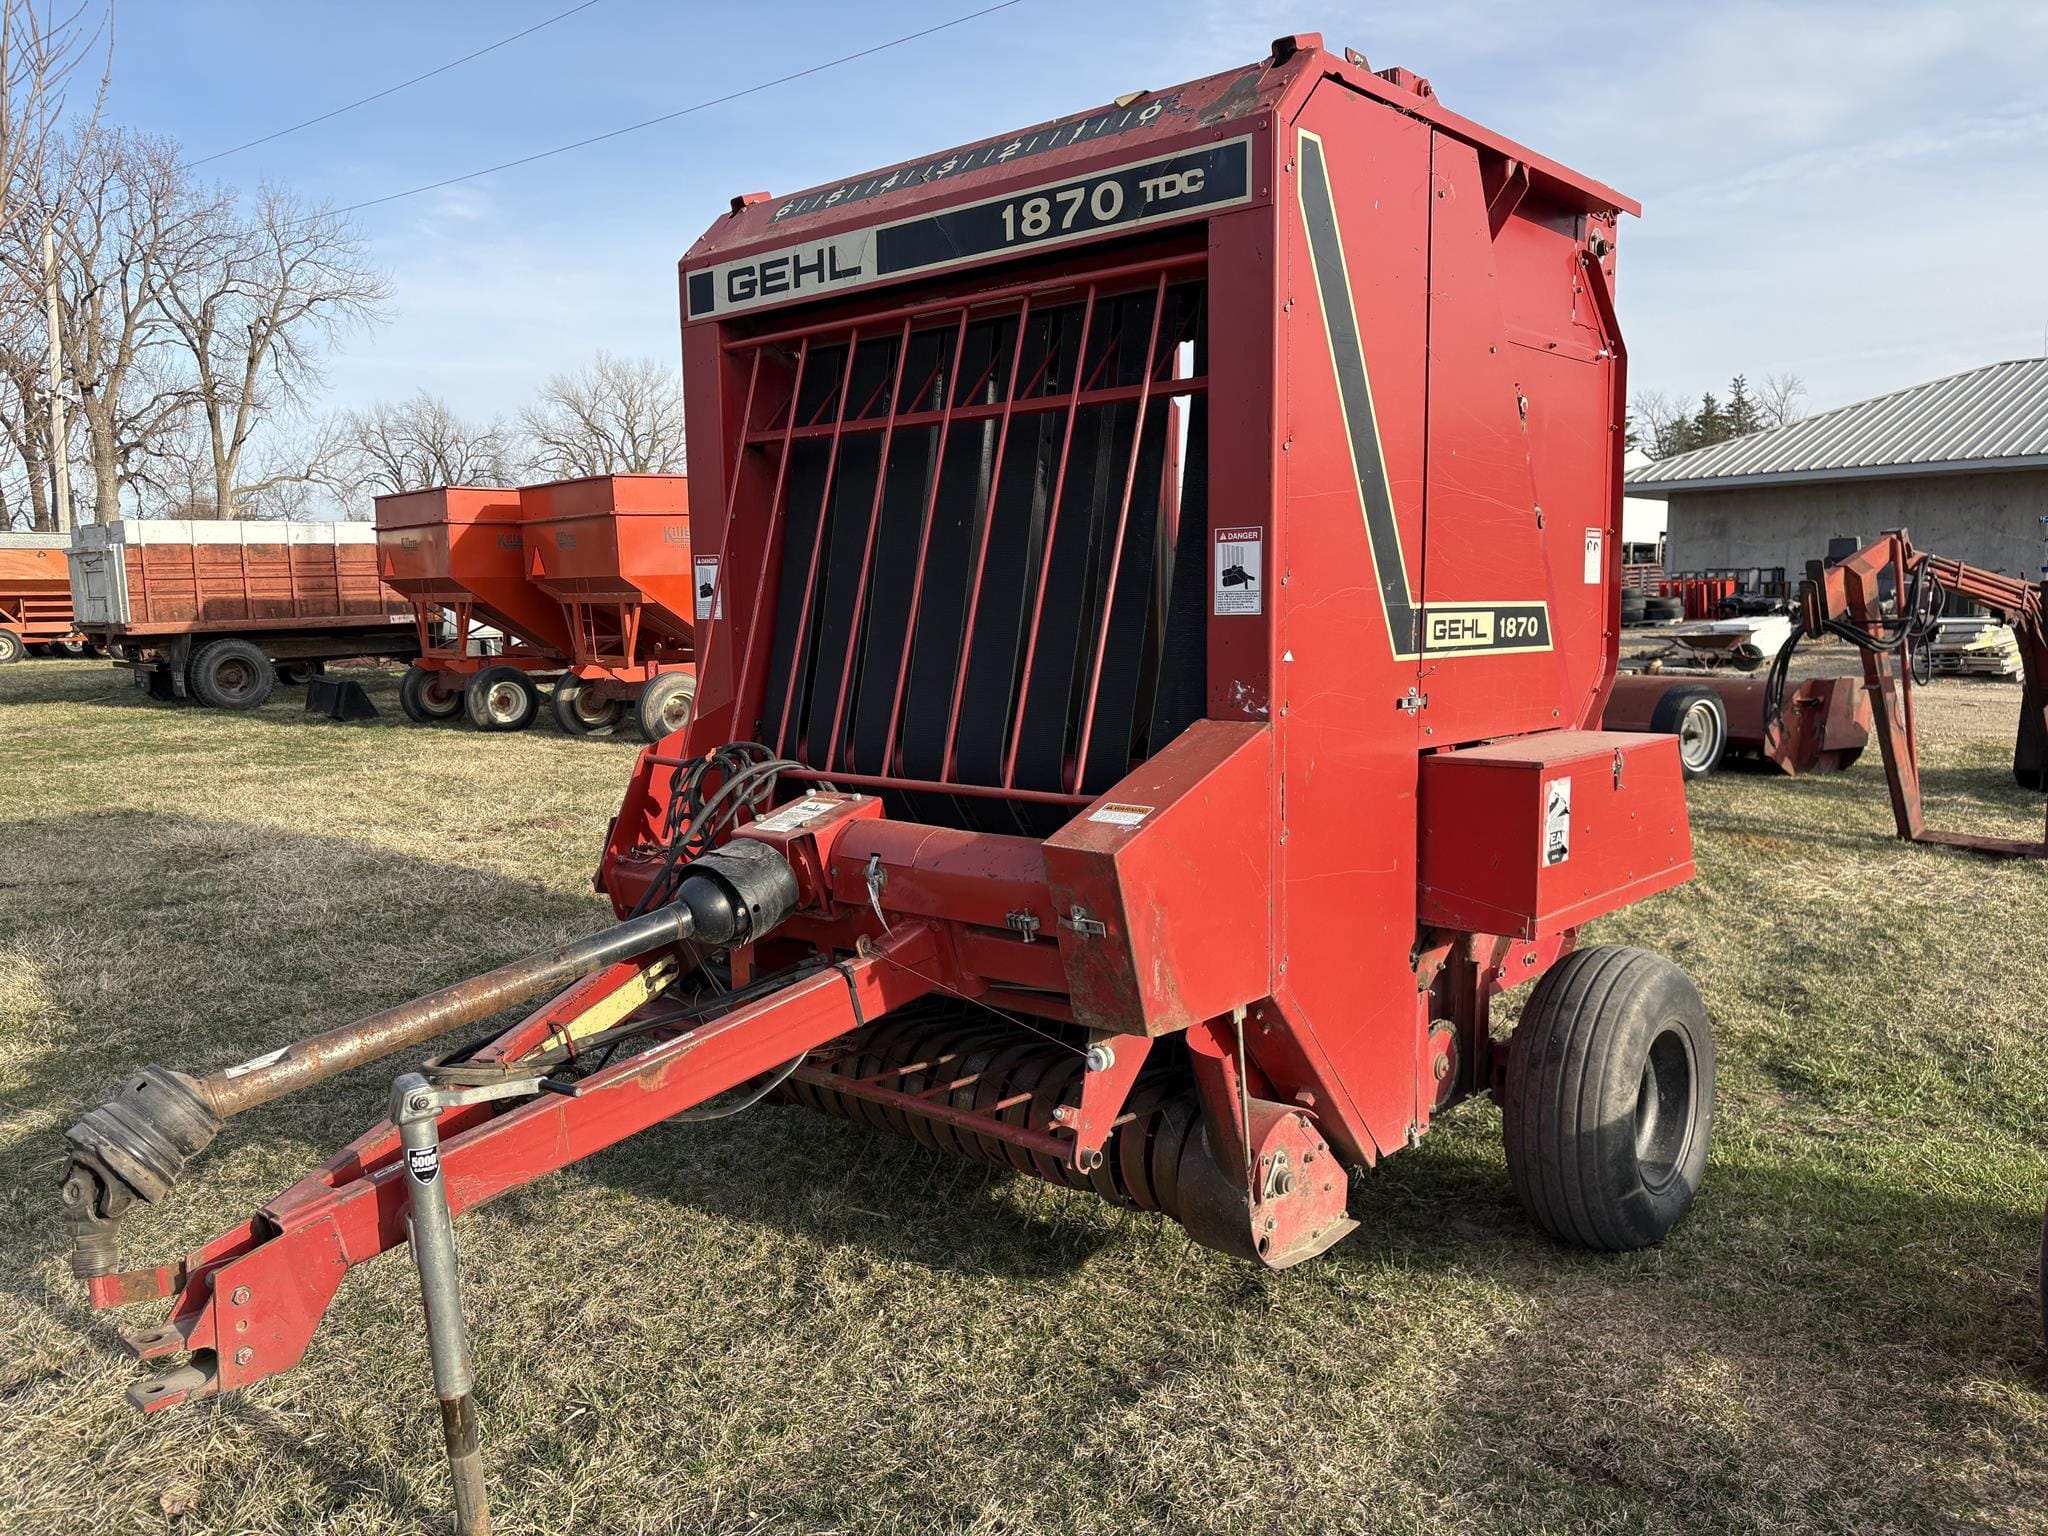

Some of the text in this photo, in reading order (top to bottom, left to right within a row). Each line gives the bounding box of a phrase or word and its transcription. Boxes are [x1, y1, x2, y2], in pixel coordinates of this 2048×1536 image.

[825, 188, 845, 204] 5
[880, 173, 900, 189] 4
[936, 159, 958, 175] 3
[997, 142, 1022, 159] 2
[727, 167, 1205, 303] GEHL 1870 TDC
[1227, 531, 1258, 540] DANGER
[1433, 616, 1539, 640] GEHL 1870
[411, 1153, 437, 1168] 5000
